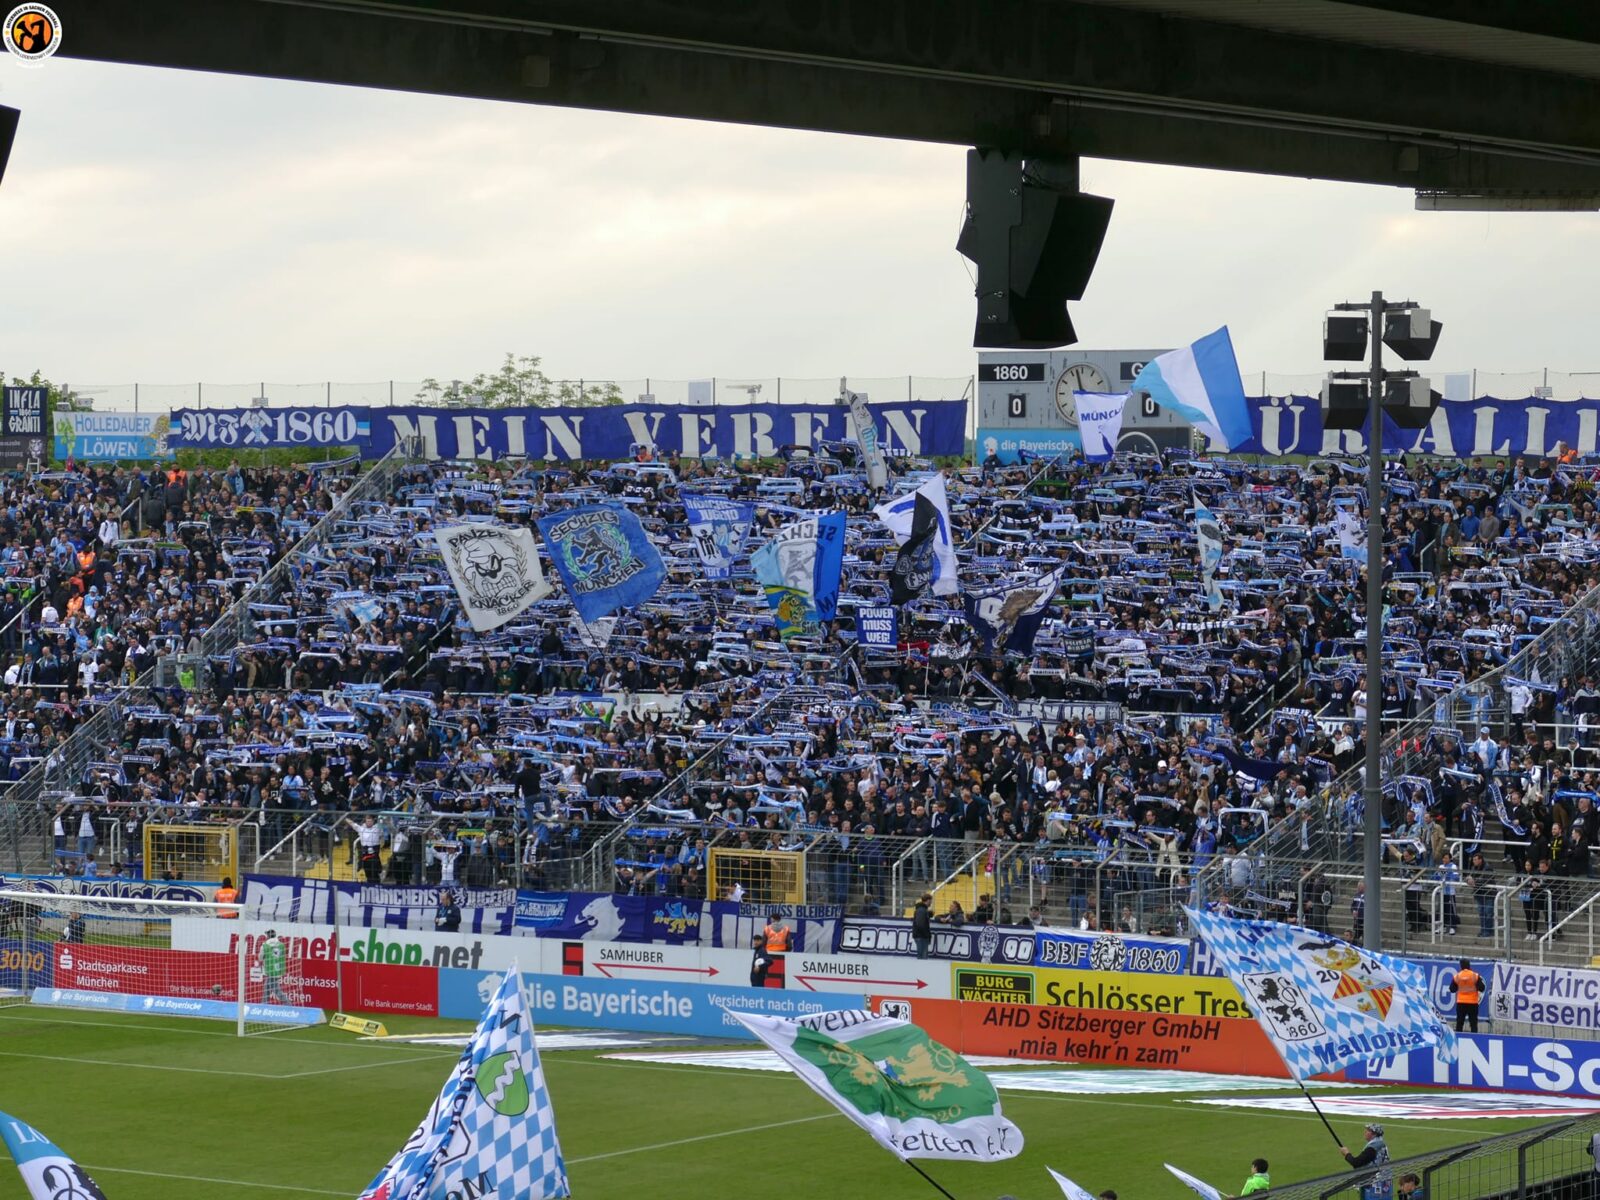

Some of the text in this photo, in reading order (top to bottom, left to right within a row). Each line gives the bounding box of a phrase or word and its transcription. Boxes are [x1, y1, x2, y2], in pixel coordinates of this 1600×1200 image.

[993, 366, 1028, 380] 1860
[9, 390, 40, 408] INFLA
[1012, 398, 1022, 414] 0
[8, 416, 40, 433] GRANTI
[74, 414, 151, 433] HOLLEDAUER
[273, 410, 356, 443] 1860
[1206, 396, 1368, 456] ÜR
[387, 414, 584, 460] MEIN
[82, 438, 138, 457] LÖWEN
[1001, 440, 1074, 453] die Bayerische
[549, 510, 619, 543] SECHZIG
[573, 556, 646, 593] MÜNCHEN
[469, 580, 537, 610] KNACKER
[860, 607, 893, 619] POWER
[863, 619, 892, 631] MUSS
[866, 632, 890, 643] WEG!
[361, 885, 517, 906] MÜNCHENS JUGEND
[764, 904, 793, 917] MUSS
[796, 904, 842, 918] BLEIBEN!
[600, 948, 664, 963] SAMHUBER
[1040, 939, 1181, 973] BBF 1860
[76, 960, 148, 975] Stadtsparkasse
[802, 960, 870, 976] SAMHUBER
[1316, 961, 1382, 984] 20 14
[76, 975, 119, 988] München
[169, 985, 178, 993] Die
[180, 986, 195, 995] Bank
[975, 975, 1014, 989] BURG
[1497, 965, 1599, 1000] Vierkirc
[62, 993, 109, 1004] die Bayerische
[523, 985, 693, 1018] die Bayerische
[707, 993, 823, 1013] Versichert nach dem
[962, 987, 1026, 1004] WÄCHTER
[1046, 981, 1184, 1013] Schlösser
[154, 998, 202, 1011] die Bayerische
[249, 1007, 300, 1018] die Bayerische
[364, 999, 374, 1007] Die
[376, 1000, 391, 1008] Bank
[416, 1003, 435, 1011] Stadt.
[983, 1006, 1221, 1041] AHD Sitzberger GmbH
[1287, 1023, 1318, 1038] 1860
[1313, 1029, 1426, 1065] Mallorca
